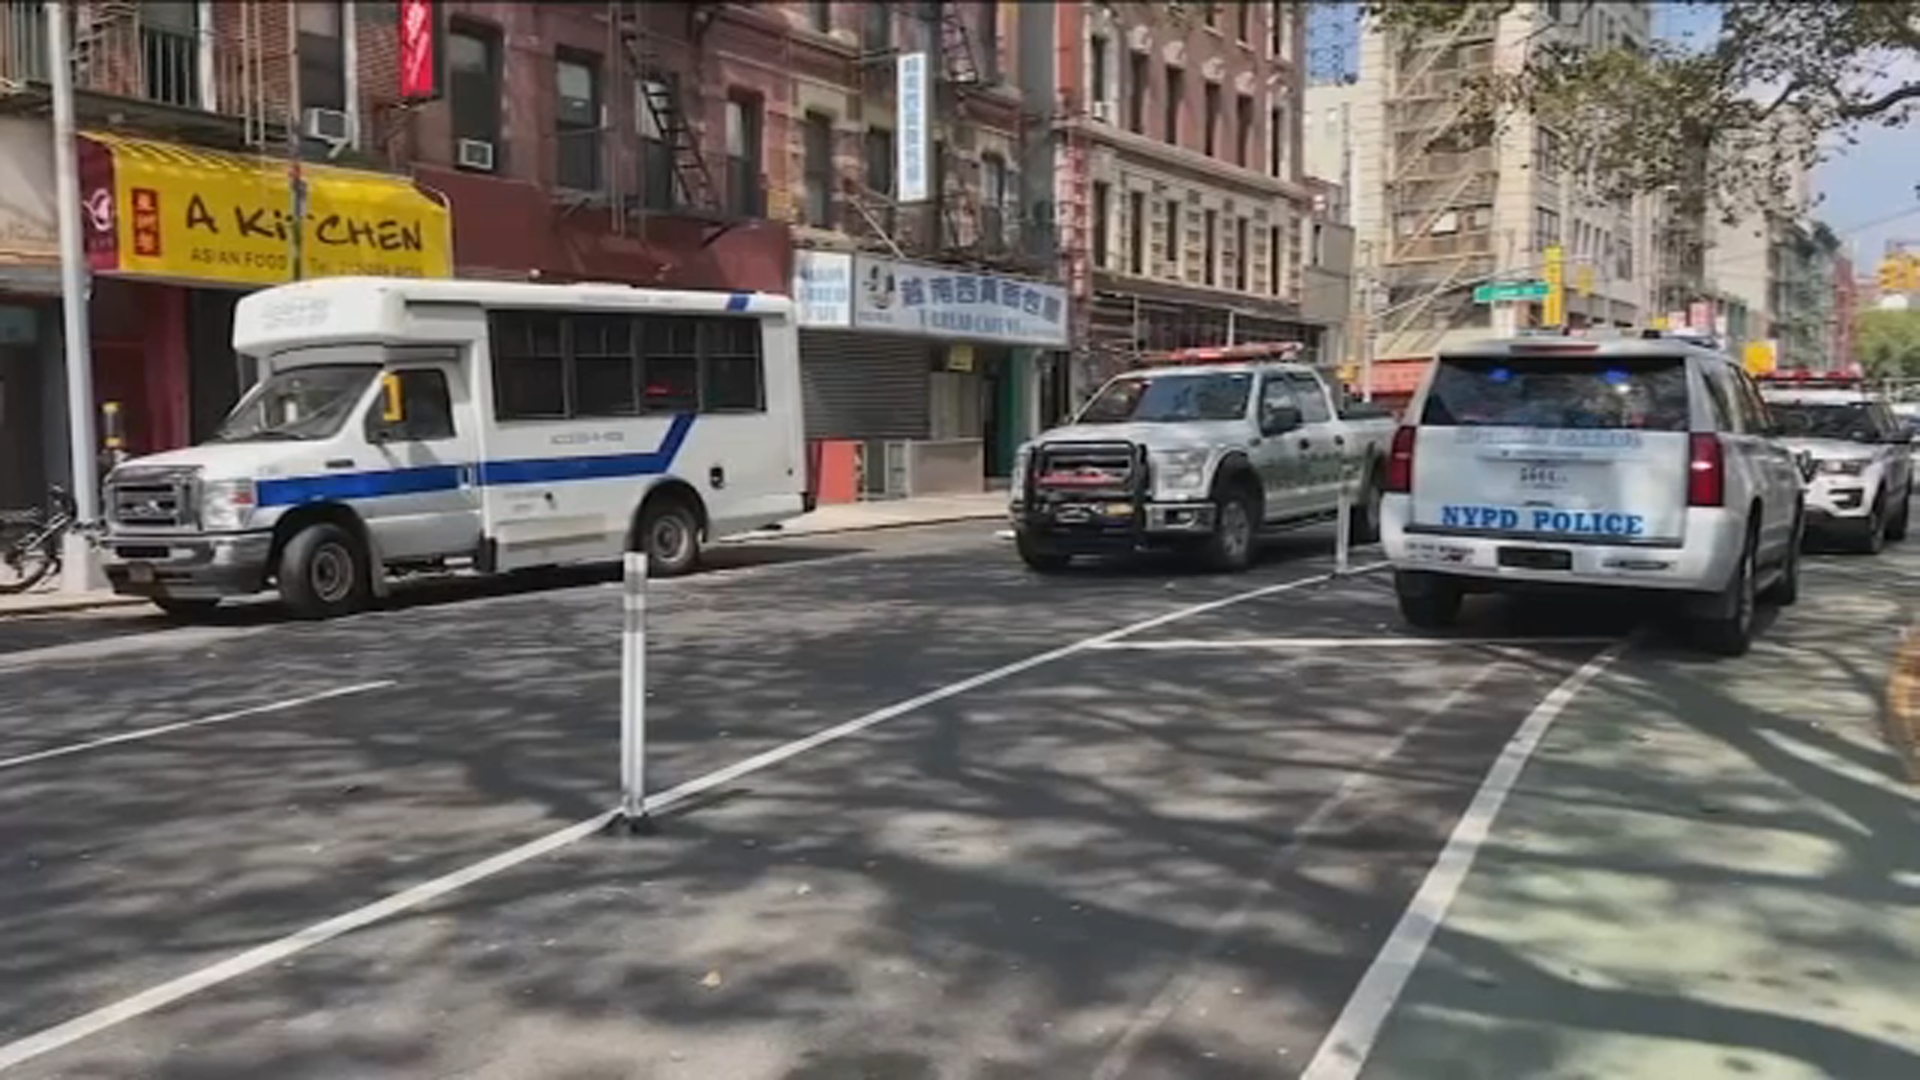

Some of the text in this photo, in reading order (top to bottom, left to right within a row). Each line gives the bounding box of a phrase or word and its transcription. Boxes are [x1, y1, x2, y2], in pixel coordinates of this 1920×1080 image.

[186, 195, 219, 235] A
[191, 247, 241, 265] ASIAN
[1441, 506, 1643, 534] NYPD POLICE
